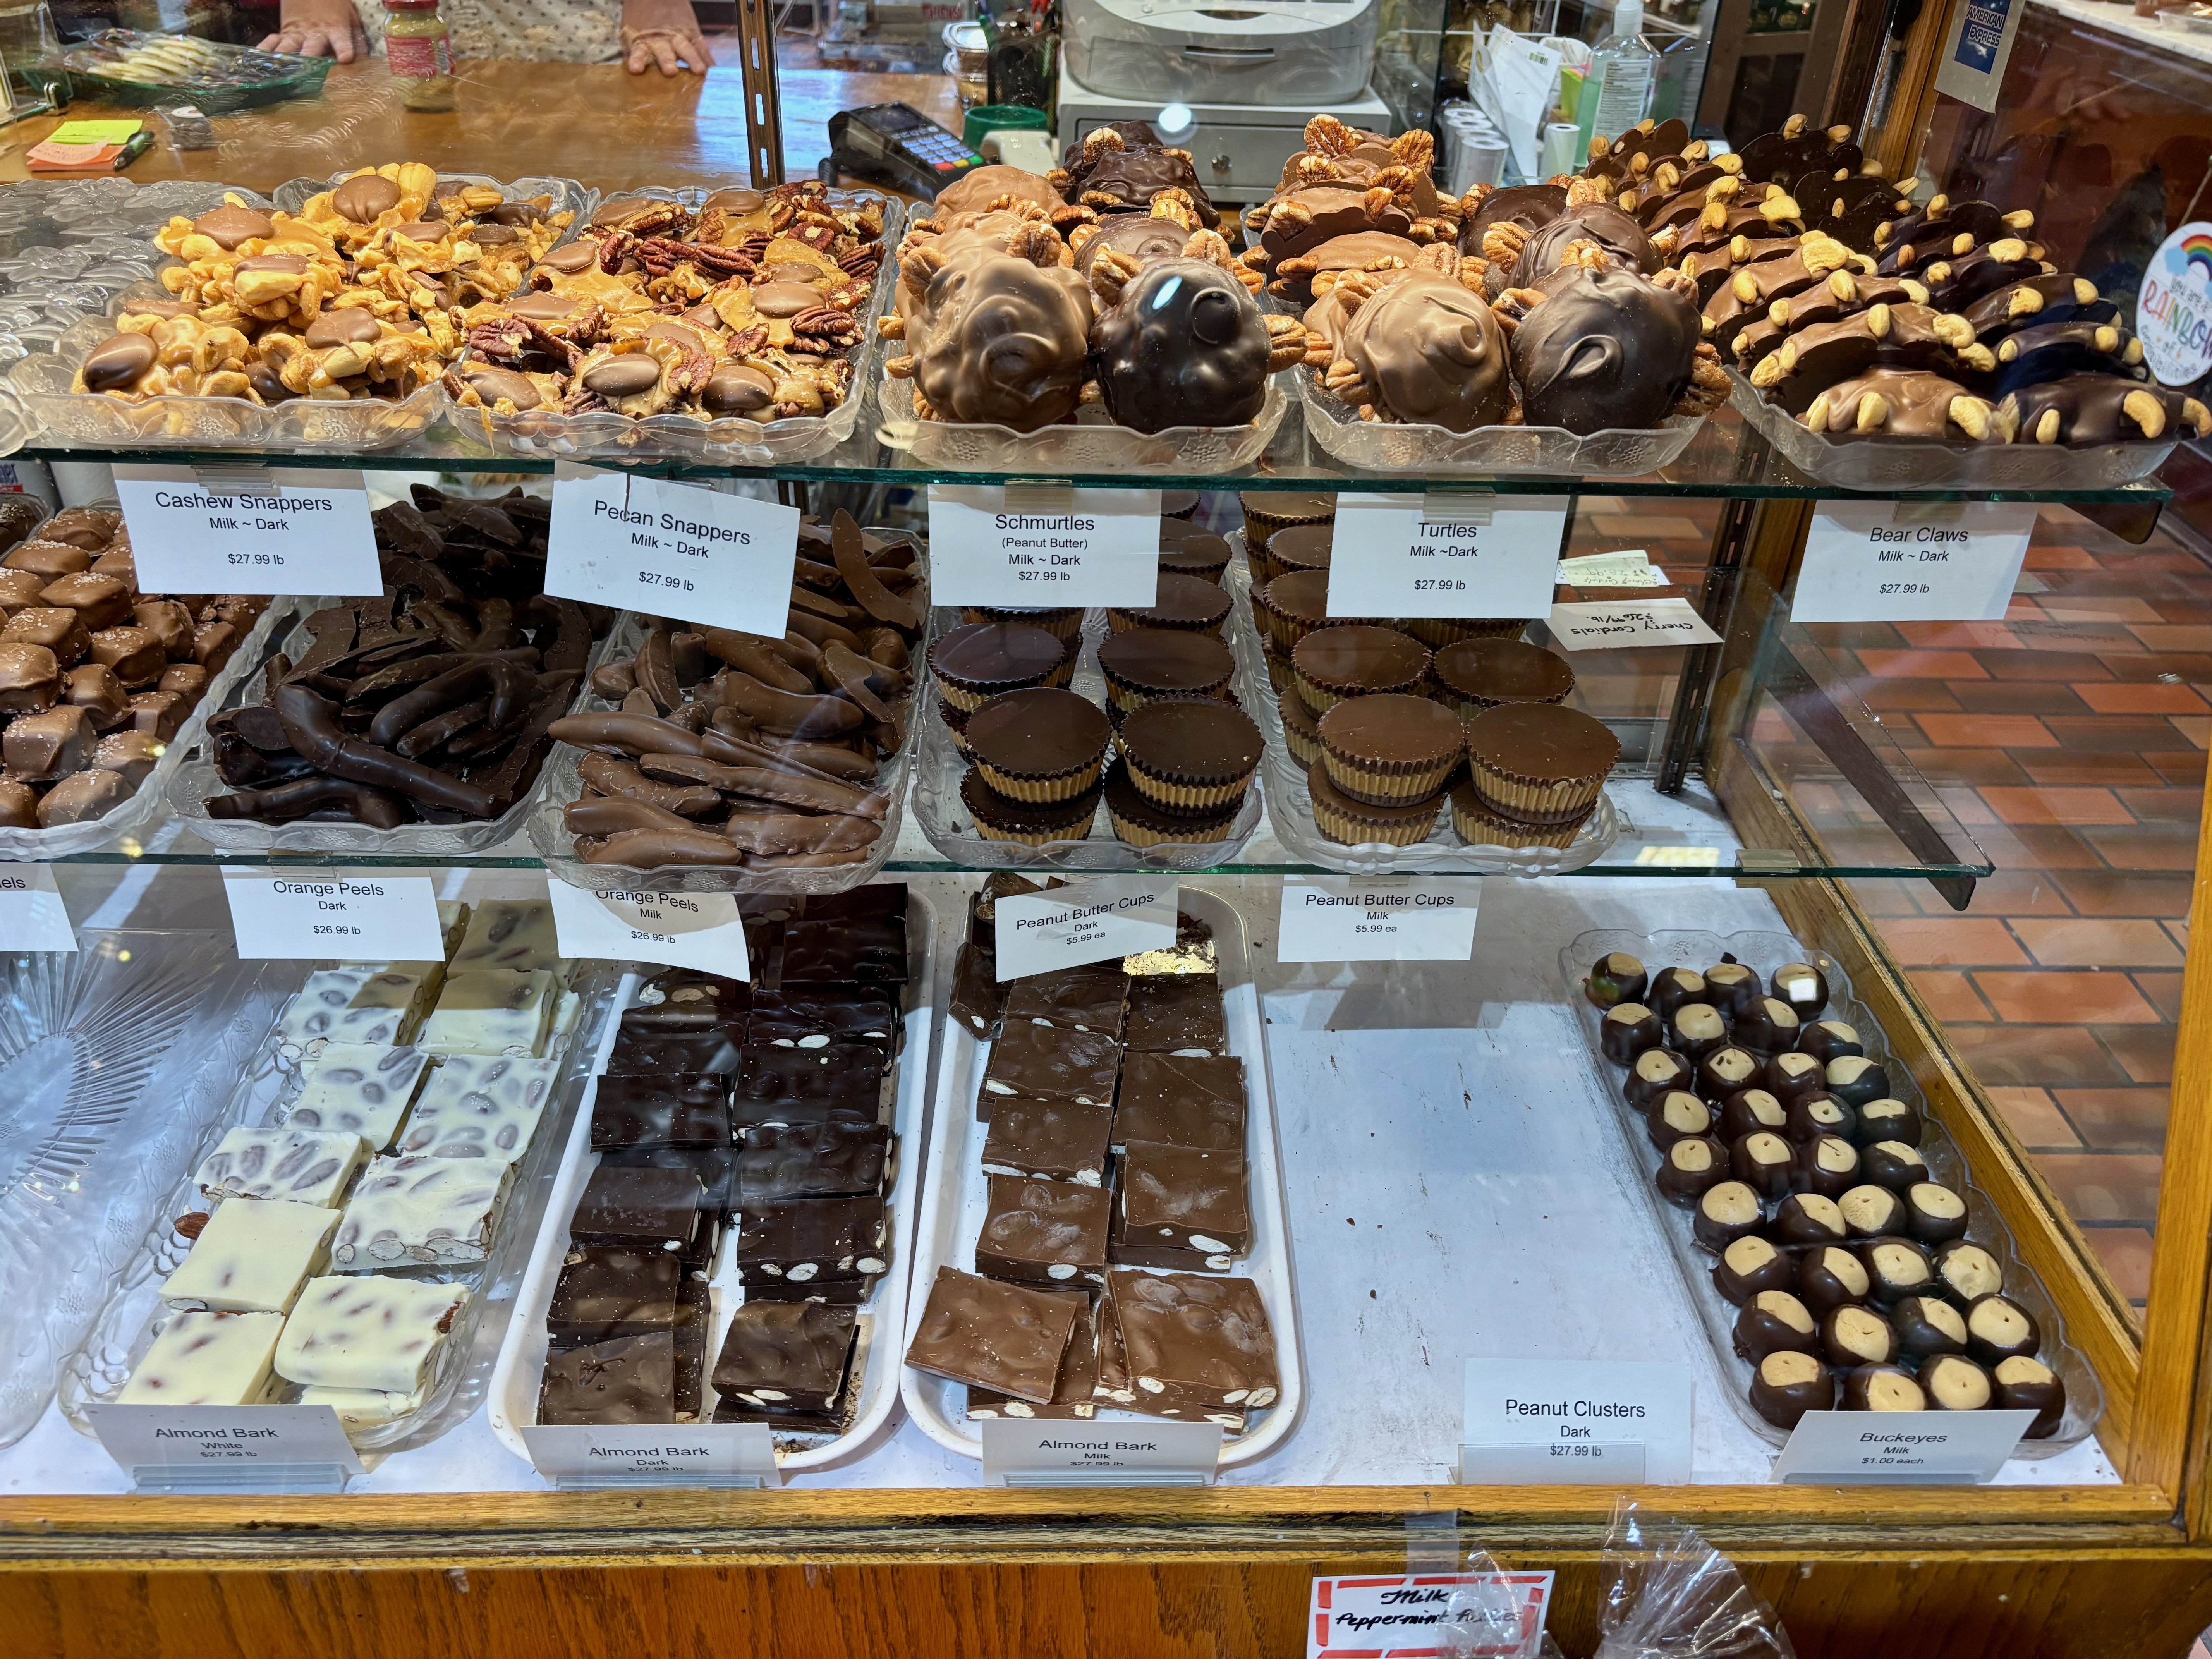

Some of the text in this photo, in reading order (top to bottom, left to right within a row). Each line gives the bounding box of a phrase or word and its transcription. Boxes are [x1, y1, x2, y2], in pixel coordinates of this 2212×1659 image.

[1966, 6, 2004, 28] AMERICAN
[1969, 26, 2001, 46] EXPRESS
[155, 492, 332, 514] Cashew Snappers
[209, 517, 239, 529] Milk
[255, 518, 290, 530] Dark
[594, 500, 750, 544] Pecan Snappers
[995, 514, 1094, 531] Schmurtles
[1417, 522, 1477, 538] Turtles
[1870, 527, 1968, 542] Bear Claws
[632, 532, 659, 549] Milk
[677, 541, 709, 558] Dark
[1002, 537, 1087, 550] (Peanut Butter)
[1410, 546, 1436, 556] Milk
[1878, 550, 1904, 562] Milk
[1919, 550, 1949, 561] Dark
[228, 553, 284, 565] $27.99 lb
[1009, 554, 1034, 565] Milk
[1051, 555, 1080, 565] Dark
[639, 571, 694, 591] $27.99 lb
[1018, 571, 1070, 581] $27.99 lb
[1414, 579, 1465, 591] $27.99 lb
[1879, 584, 1929, 594] $27.99 lb
[1570, 620, 1693, 636] Cherry Cordials
[0, 876, 26, 888] els
[273, 881, 384, 897] Orange Peels
[318, 901, 347, 910] Dark
[659, 892, 699, 912] Peels
[1306, 894, 1455, 908] Peanut Butter Cups
[640, 908, 662, 920] Milk
[1017, 894, 1154, 930] Peanut Butter Cups
[1367, 911, 1389, 920] Milk
[313, 925, 361, 934] $26.99 lb
[1075, 921, 1098, 932] Dark
[1355, 925, 1382, 933] $5.99
[631, 931, 675, 943] $26.99 lb
[1066, 933, 1092, 945] $5.99
[1506, 1399, 1645, 1418] Peanut Clusters
[156, 1428, 279, 1438] Almond Bark
[1561, 1425, 1590, 1437] Dark
[1860, 1433, 1948, 1444] Buckeyes
[589, 1447, 710, 1456] Almond Bark
[1038, 1440, 1157, 1451] Almond Bark
[1550, 1443, 1602, 1456] $27.99 lb
[1381, 1588, 1449, 1605] Milk
[1335, 1610, 1448, 1631] Peppermint
